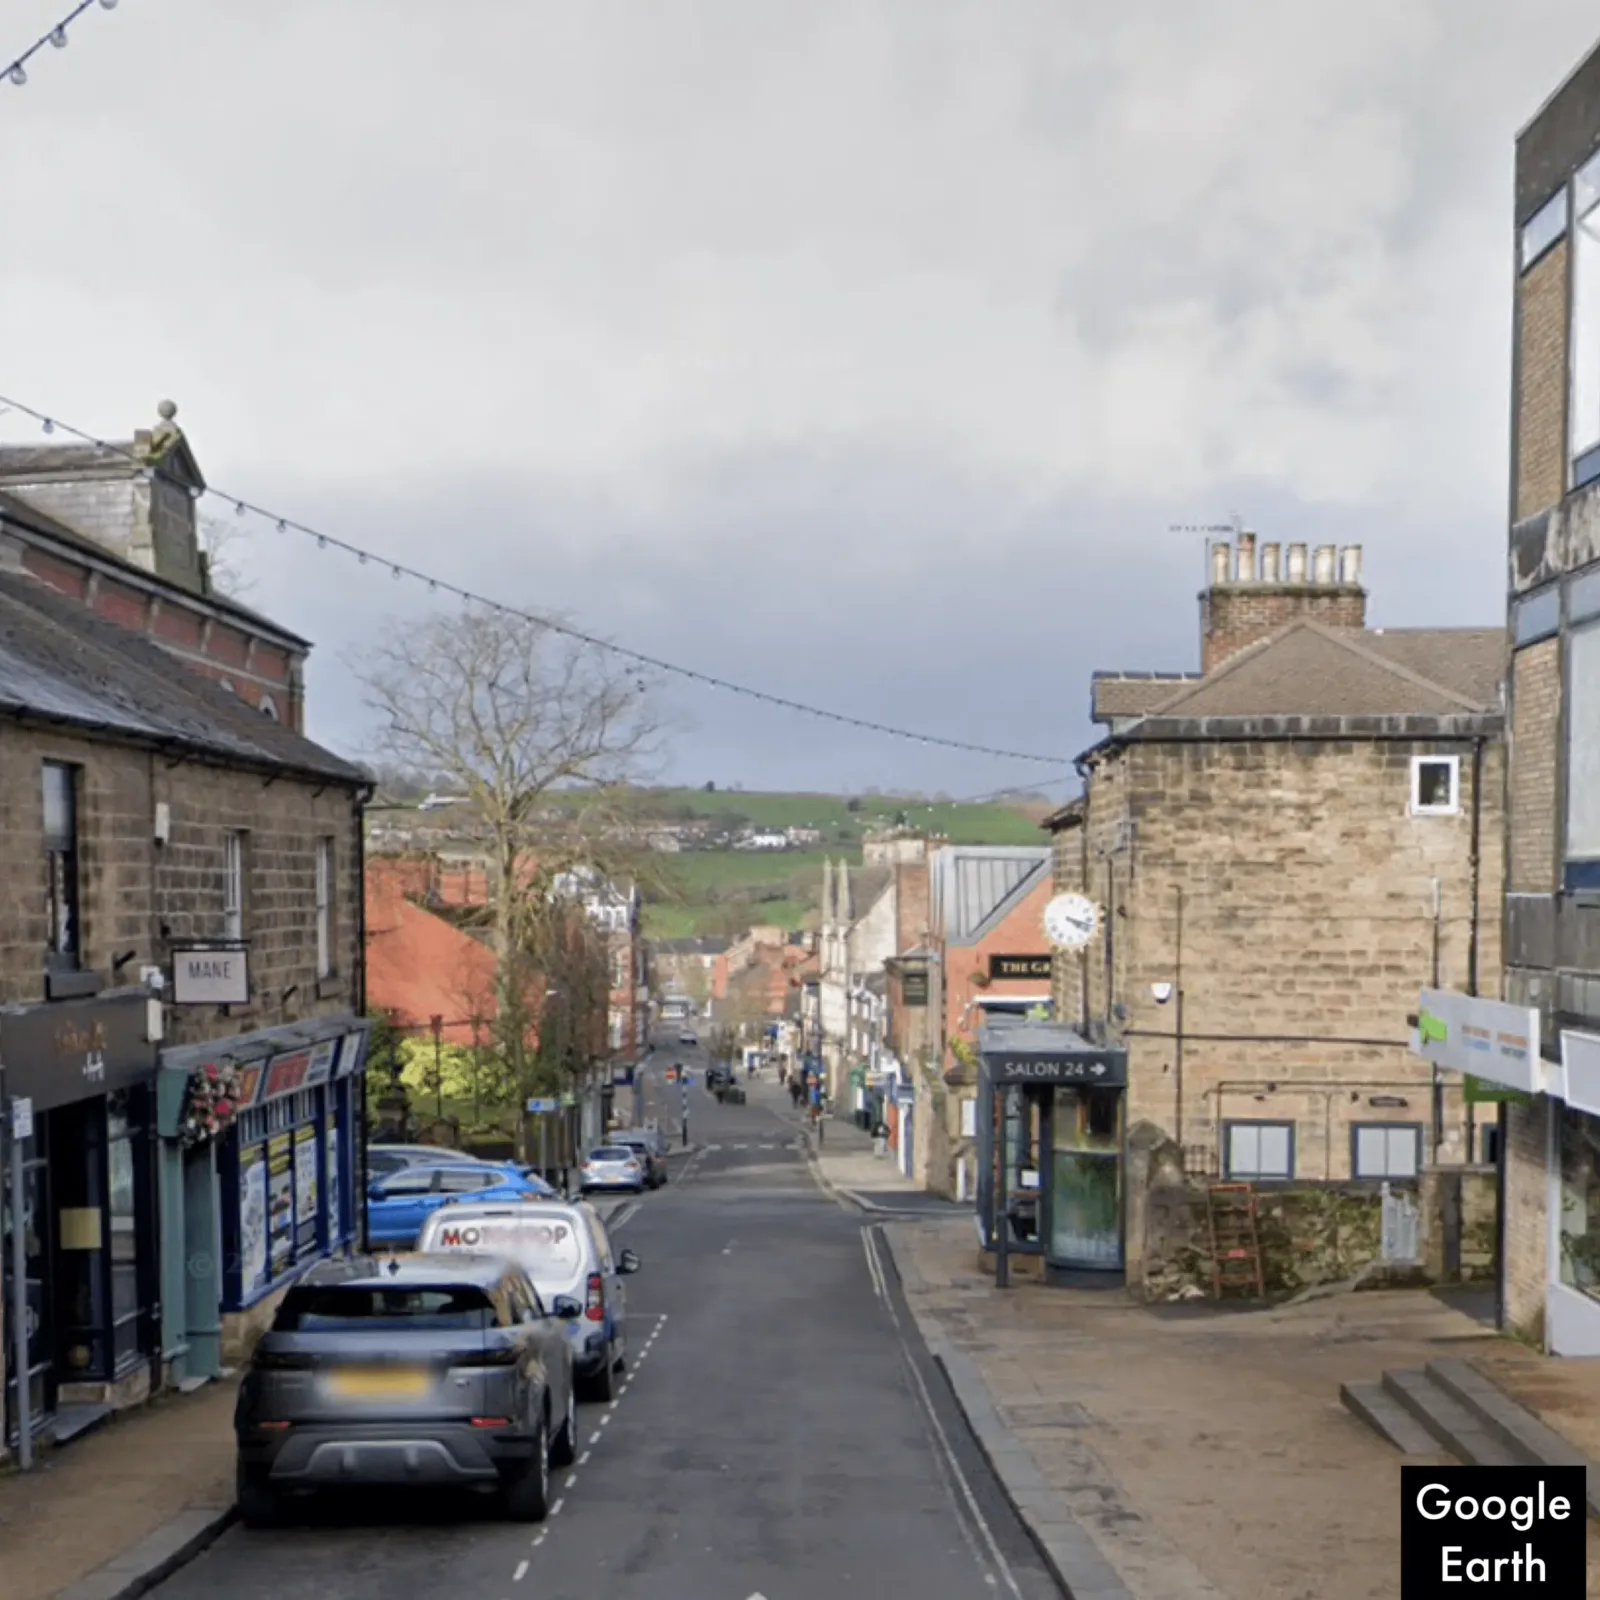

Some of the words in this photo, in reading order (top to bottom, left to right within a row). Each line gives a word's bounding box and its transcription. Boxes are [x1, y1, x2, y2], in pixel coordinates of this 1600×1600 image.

[188, 961, 232, 979] MANE
[1000, 961, 1029, 974] THE
[1005, 1061, 1060, 1076] SALON
[1064, 1062, 1085, 1075] 24
